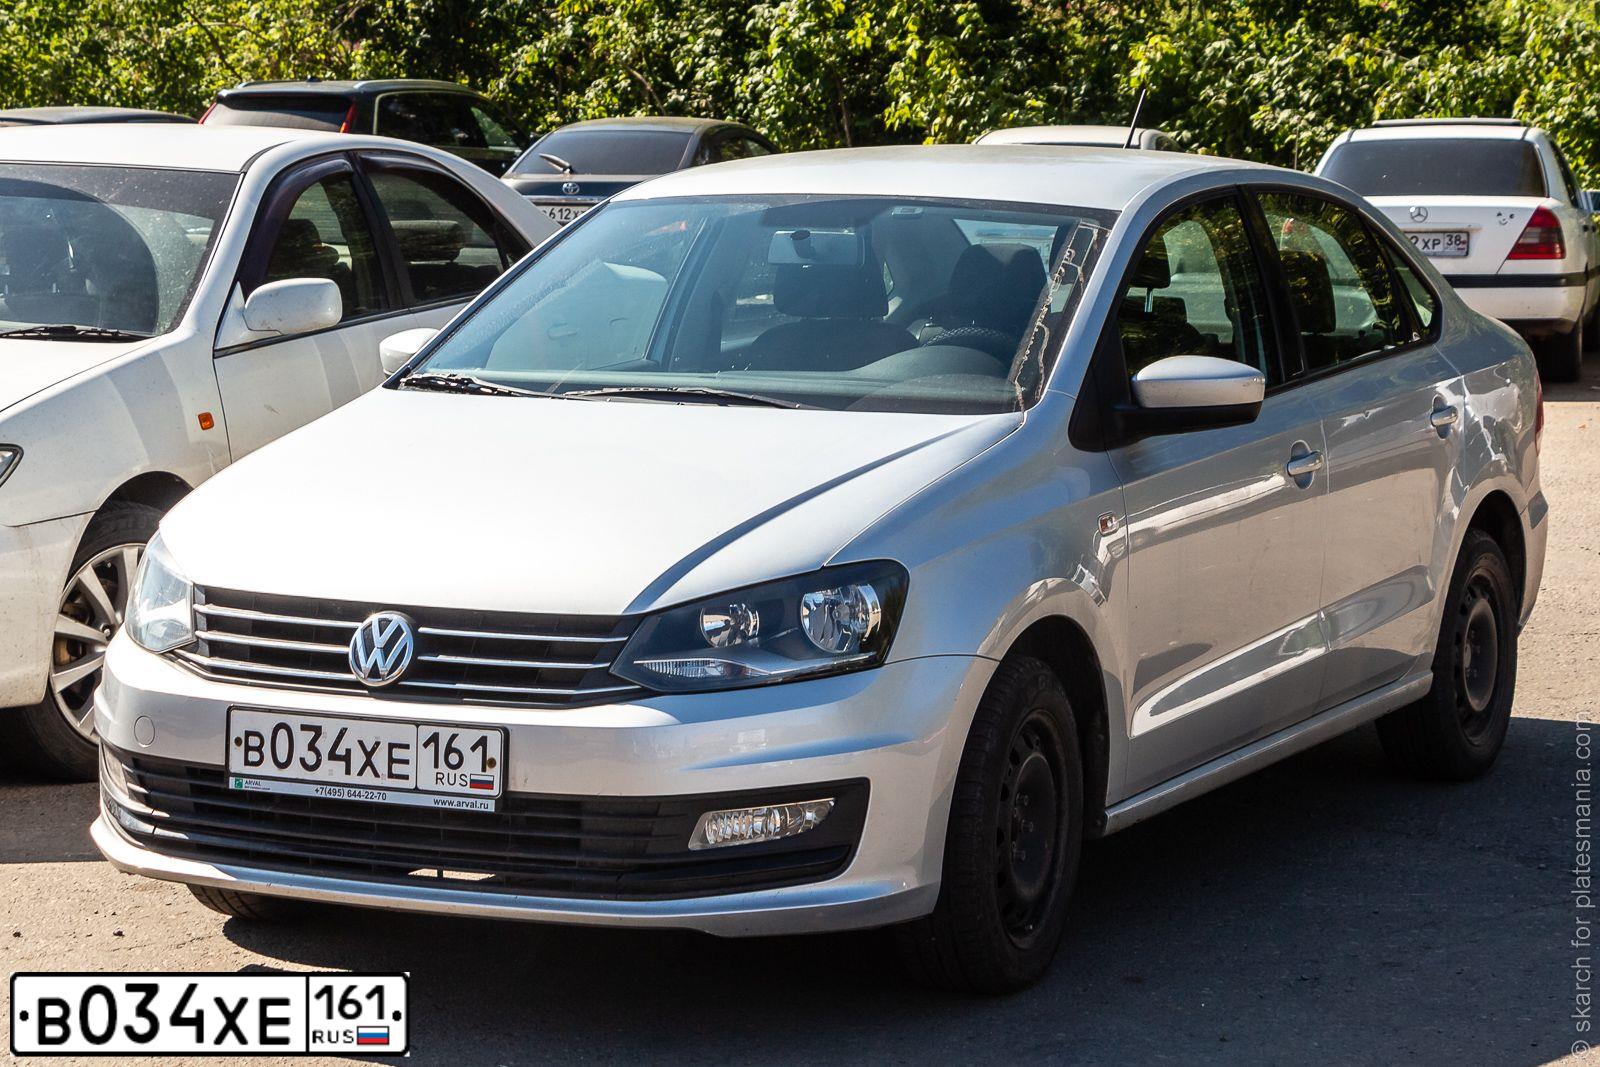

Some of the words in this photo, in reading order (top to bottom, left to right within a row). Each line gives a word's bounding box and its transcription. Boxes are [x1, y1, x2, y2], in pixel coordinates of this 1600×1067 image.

[542, 207, 586, 220] 612Х
[1446, 234, 1461, 246] 38
[243, 722, 411, 781] В034ХЕ
[422, 731, 488, 773] 161
[435, 772, 468, 787] RUS
[314, 786, 345, 798] +7(495)
[347, 789, 387, 801] 644-22-70
[433, 798, 489, 810] www.arval.ru
